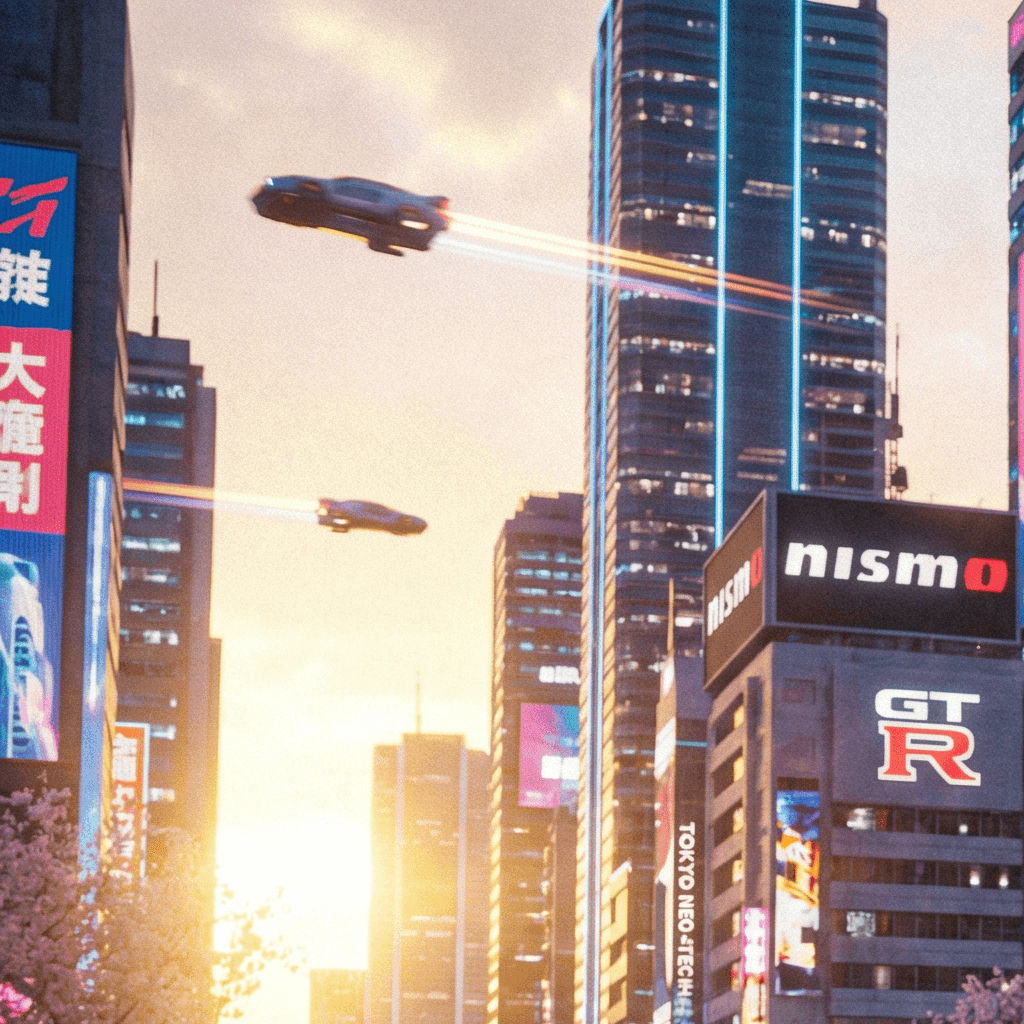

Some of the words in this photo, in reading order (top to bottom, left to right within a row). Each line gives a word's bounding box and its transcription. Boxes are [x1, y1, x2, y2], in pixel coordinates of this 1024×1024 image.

[707, 547, 763, 637] nismo
[784, 542, 1008, 593] nismo
[678, 822, 696, 890] TOKYO
